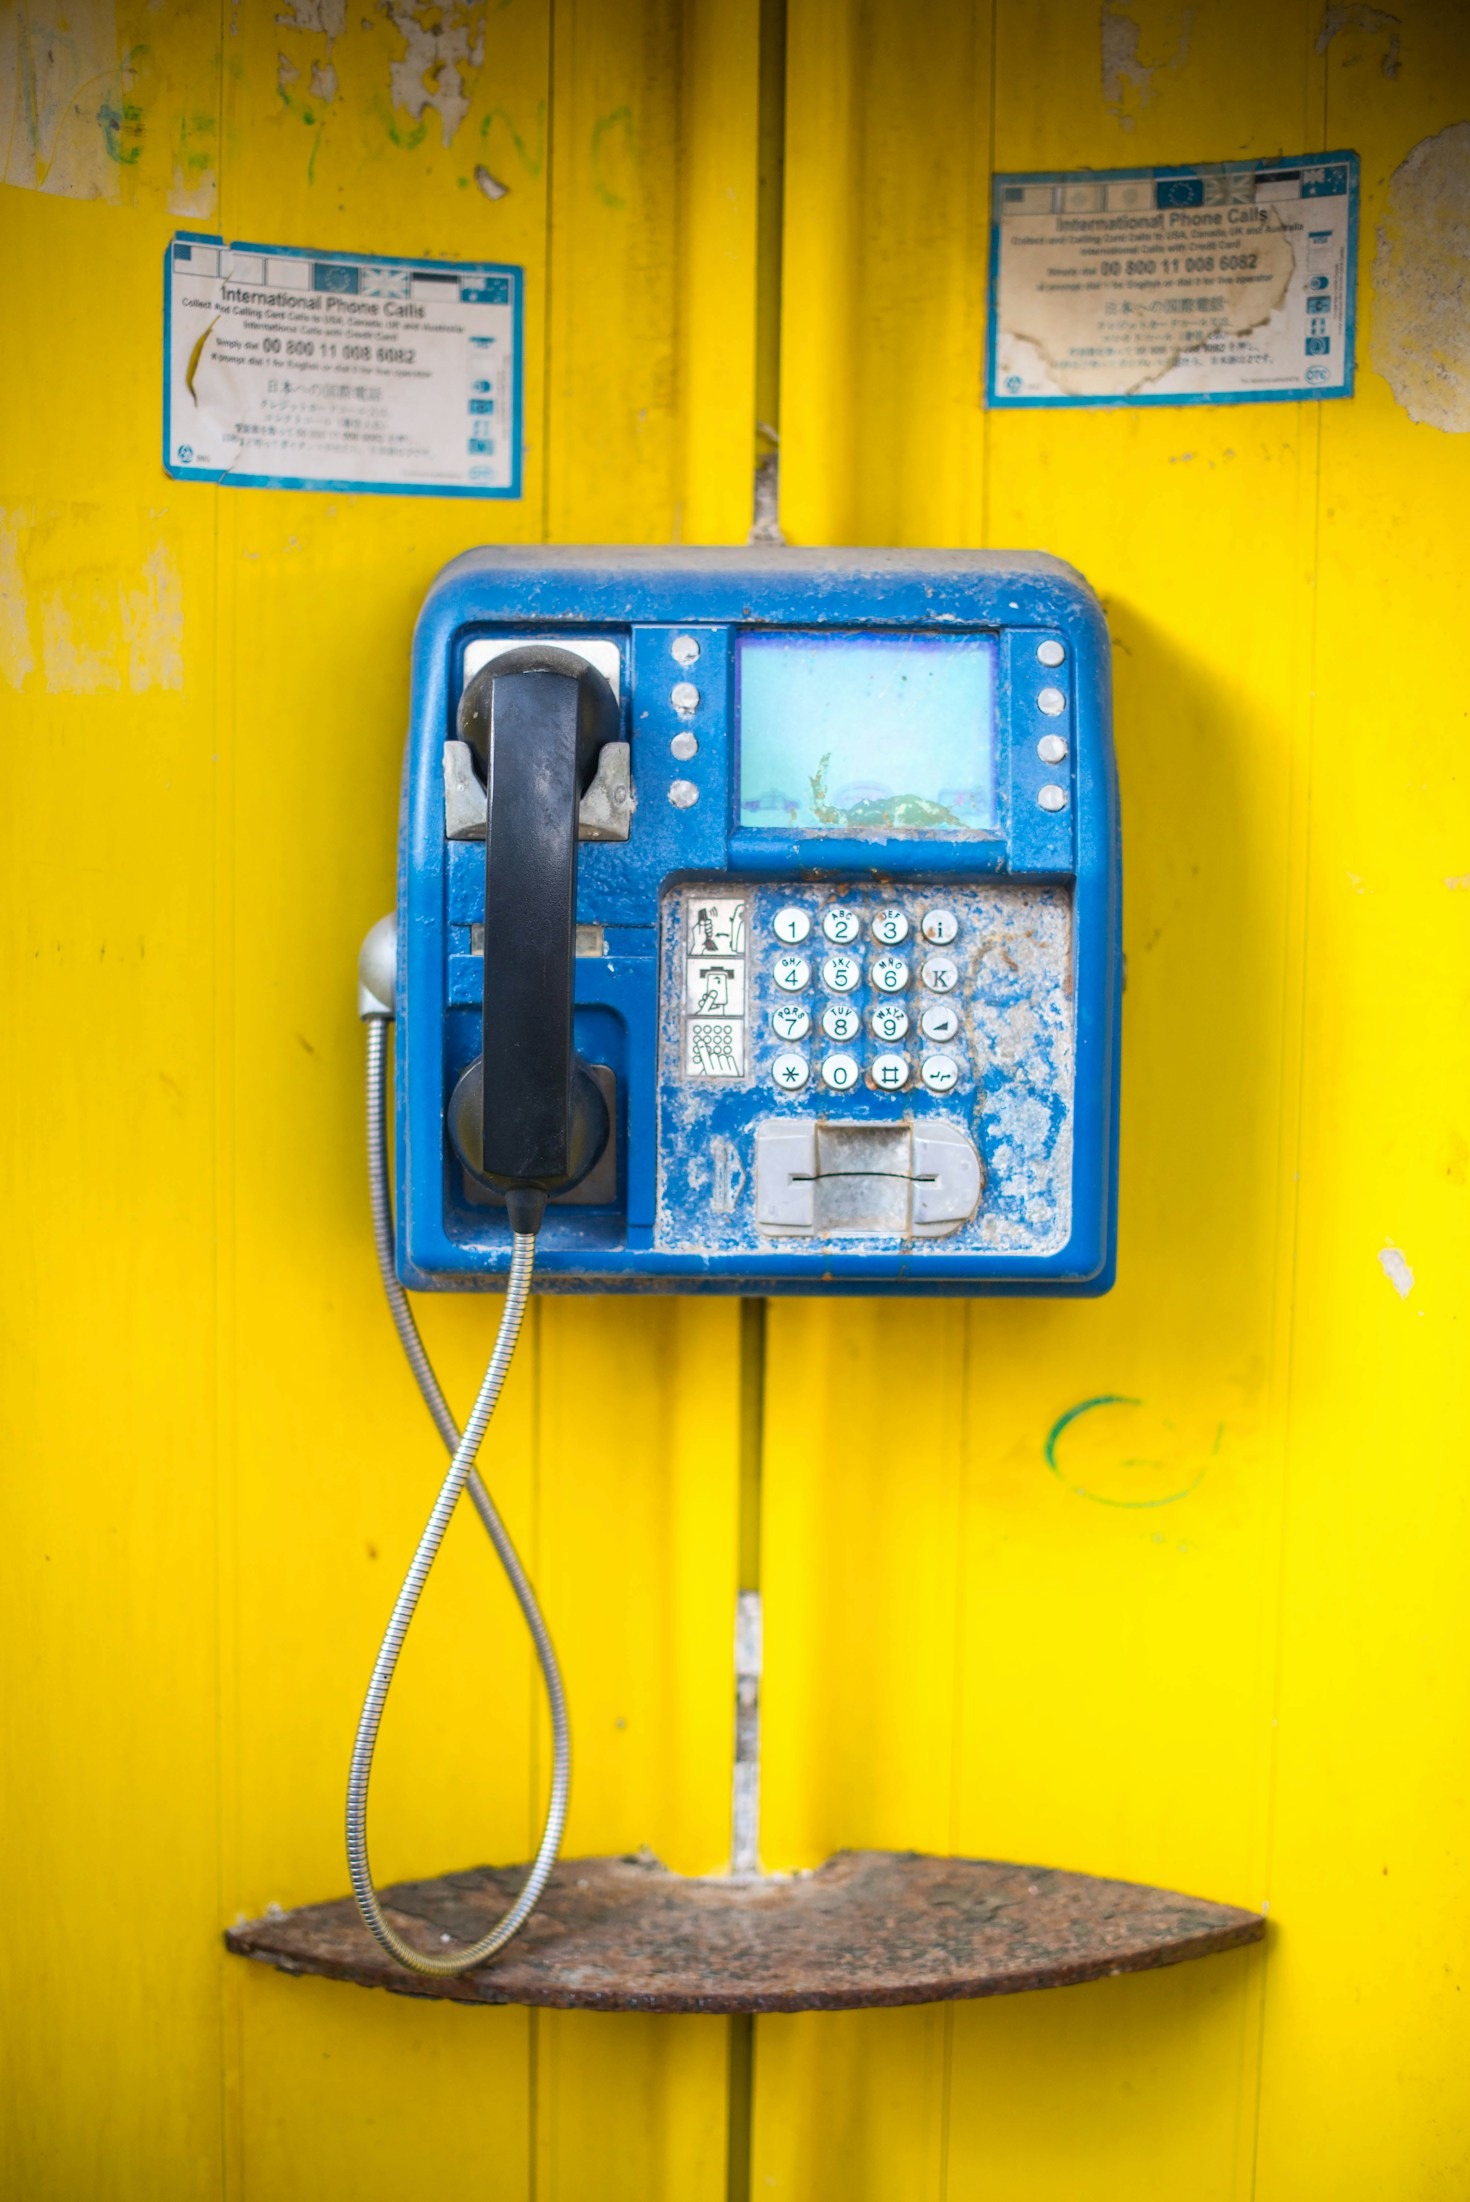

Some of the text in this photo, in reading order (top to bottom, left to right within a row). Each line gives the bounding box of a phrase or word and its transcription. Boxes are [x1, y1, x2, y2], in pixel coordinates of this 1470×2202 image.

[1056, 207, 1268, 231] International Phone Calls
[1101, 260, 1121, 276] 00
[1125, 259, 1157, 276] 800
[1162, 257, 1180, 274] 11
[1185, 256, 1215, 273] 008
[1219, 253, 1258, 271] 6082
[221, 285, 426, 319] International Phone Calls
[263, 336, 281, 353] 00
[286, 338, 315, 357] 800
[320, 342, 337, 359] 11
[342, 344, 372, 362] 008
[376, 346, 417, 365] 6082
[831, 909, 852, 921] ABC
[787, 921, 796, 939] 1
[835, 921, 848, 939] 2
[883, 922, 897, 940] 3
[937, 922, 944, 938] i
[781, 956, 802, 967] GHI
[831, 957, 851, 968] JKL
[879, 957, 903, 969] MÑO
[784, 969, 799, 987] 4
[834, 969, 848, 987] 5
[884, 970, 897, 988] 6
[933, 970, 948, 988] K
[777, 1007, 805, 1020] PQRS
[831, 1007, 851, 1017] TUV
[876, 1008, 905, 1022] WXYZ
[785, 1018, 797, 1036] 7
[834, 1019, 848, 1036] 8
[883, 1019, 897, 1037] 9
[833, 1067, 847, 1085] 0
